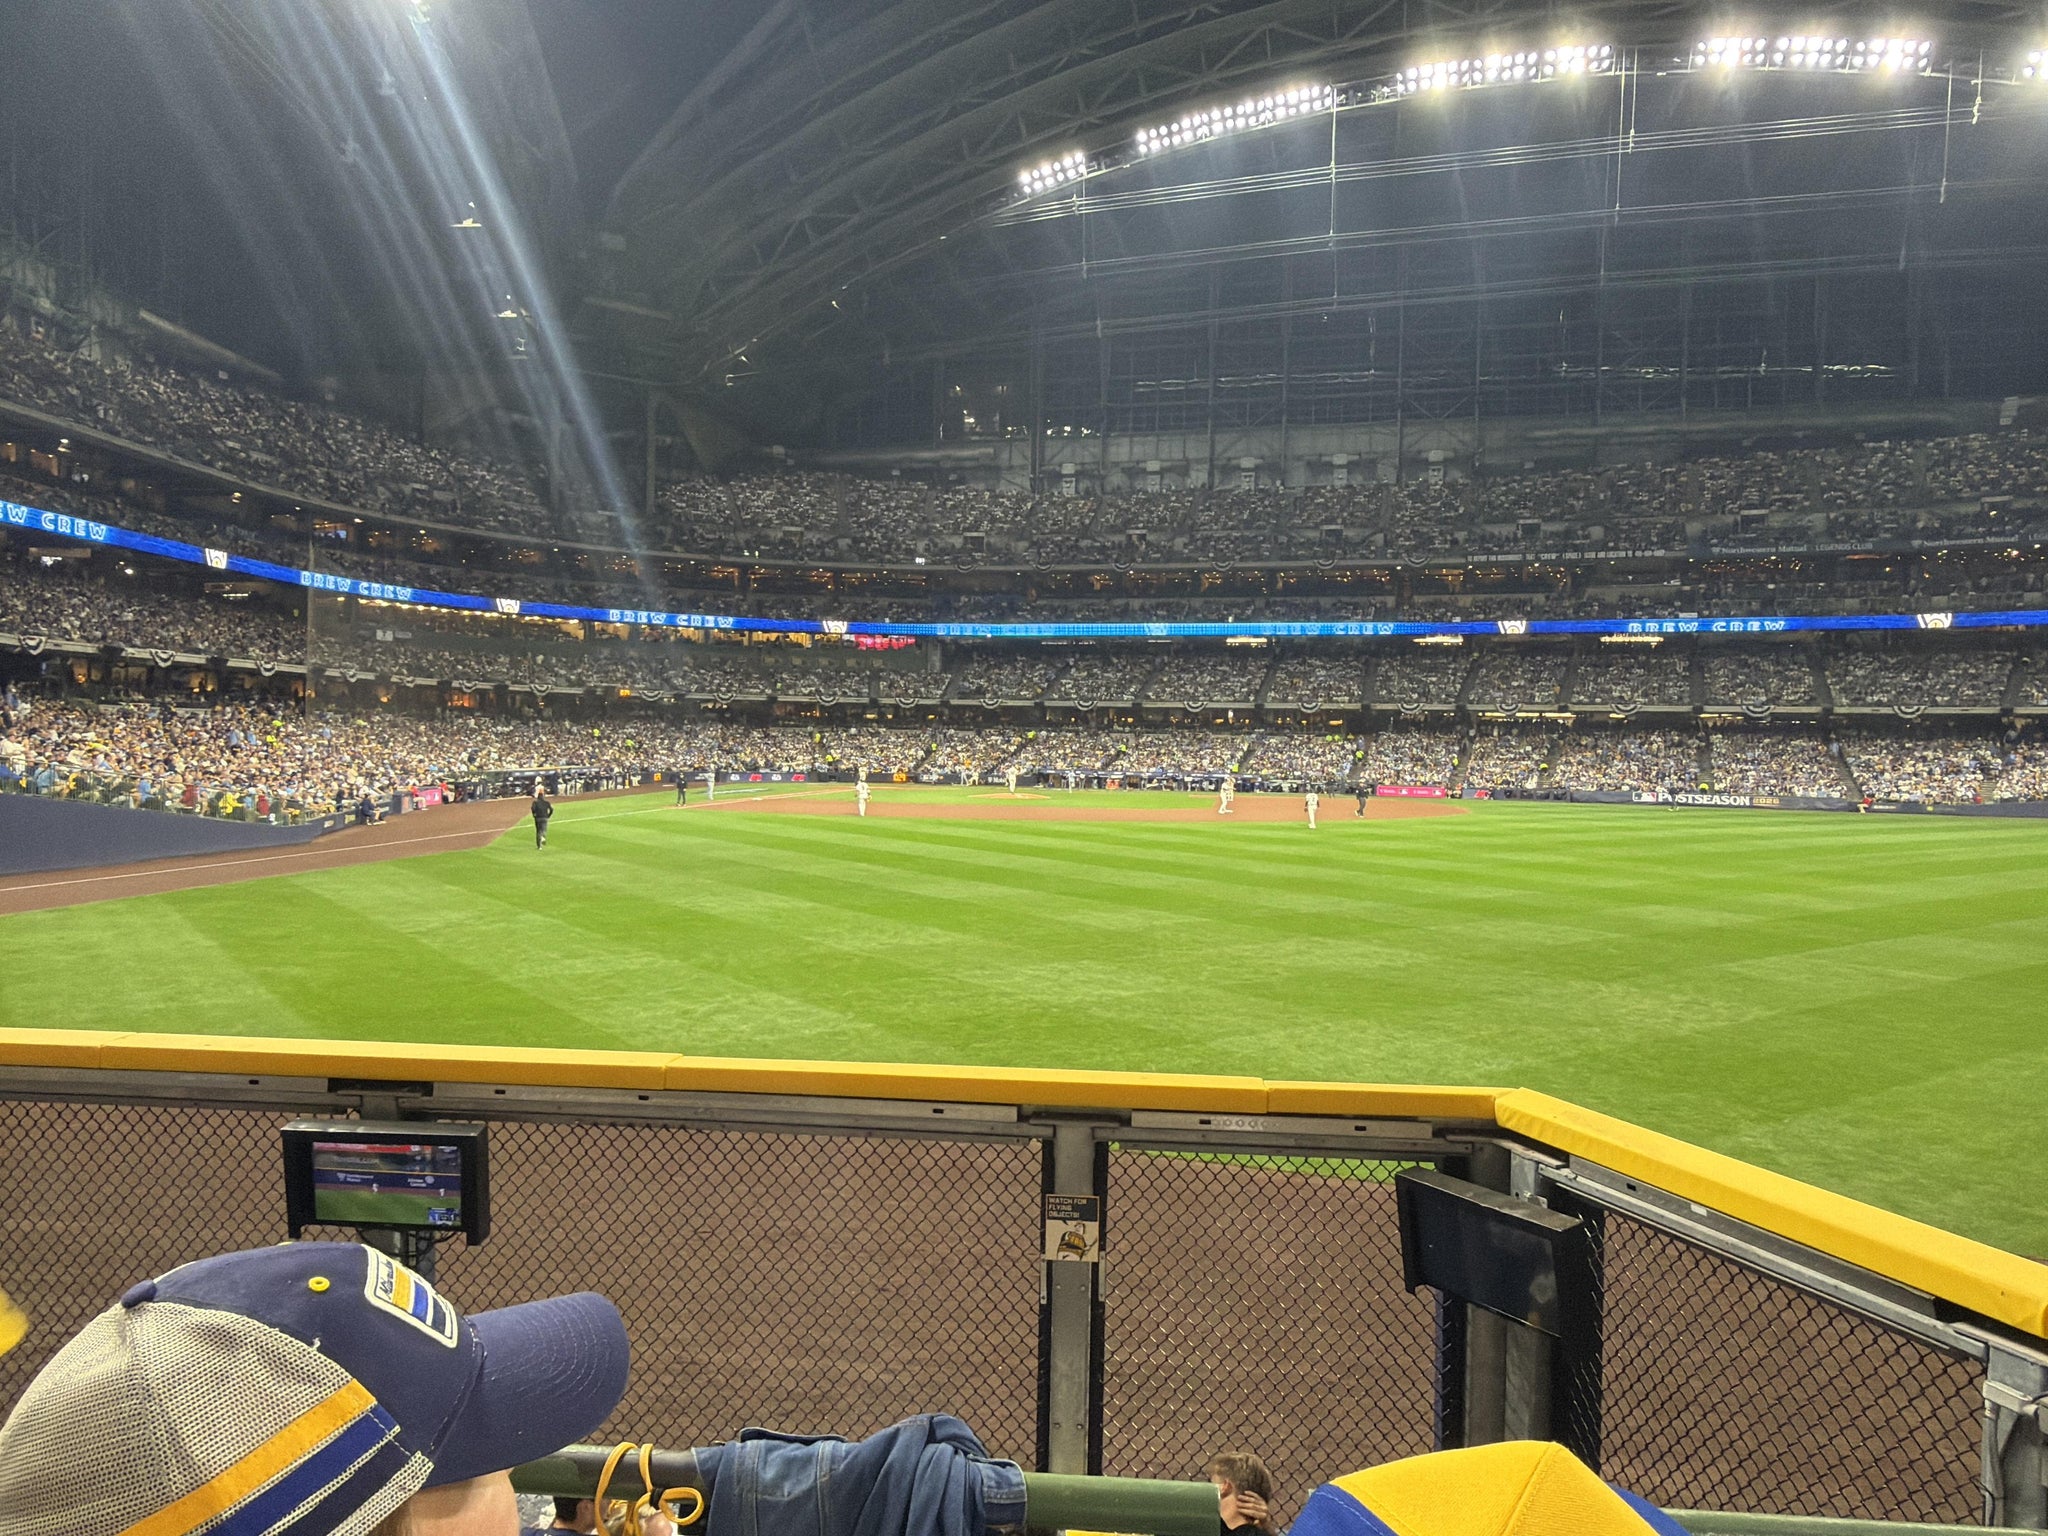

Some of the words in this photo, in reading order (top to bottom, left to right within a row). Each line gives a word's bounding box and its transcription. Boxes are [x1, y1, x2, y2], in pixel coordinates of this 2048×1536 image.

[41, 512, 106, 541] CREW
[301, 570, 351, 592] BREW
[359, 582, 412, 601] CREW
[609, 608, 667, 625] BREW
[676, 614, 734, 629] CREW
[1628, 621, 1699, 633] BREW
[1712, 620, 1786, 632] CREW
